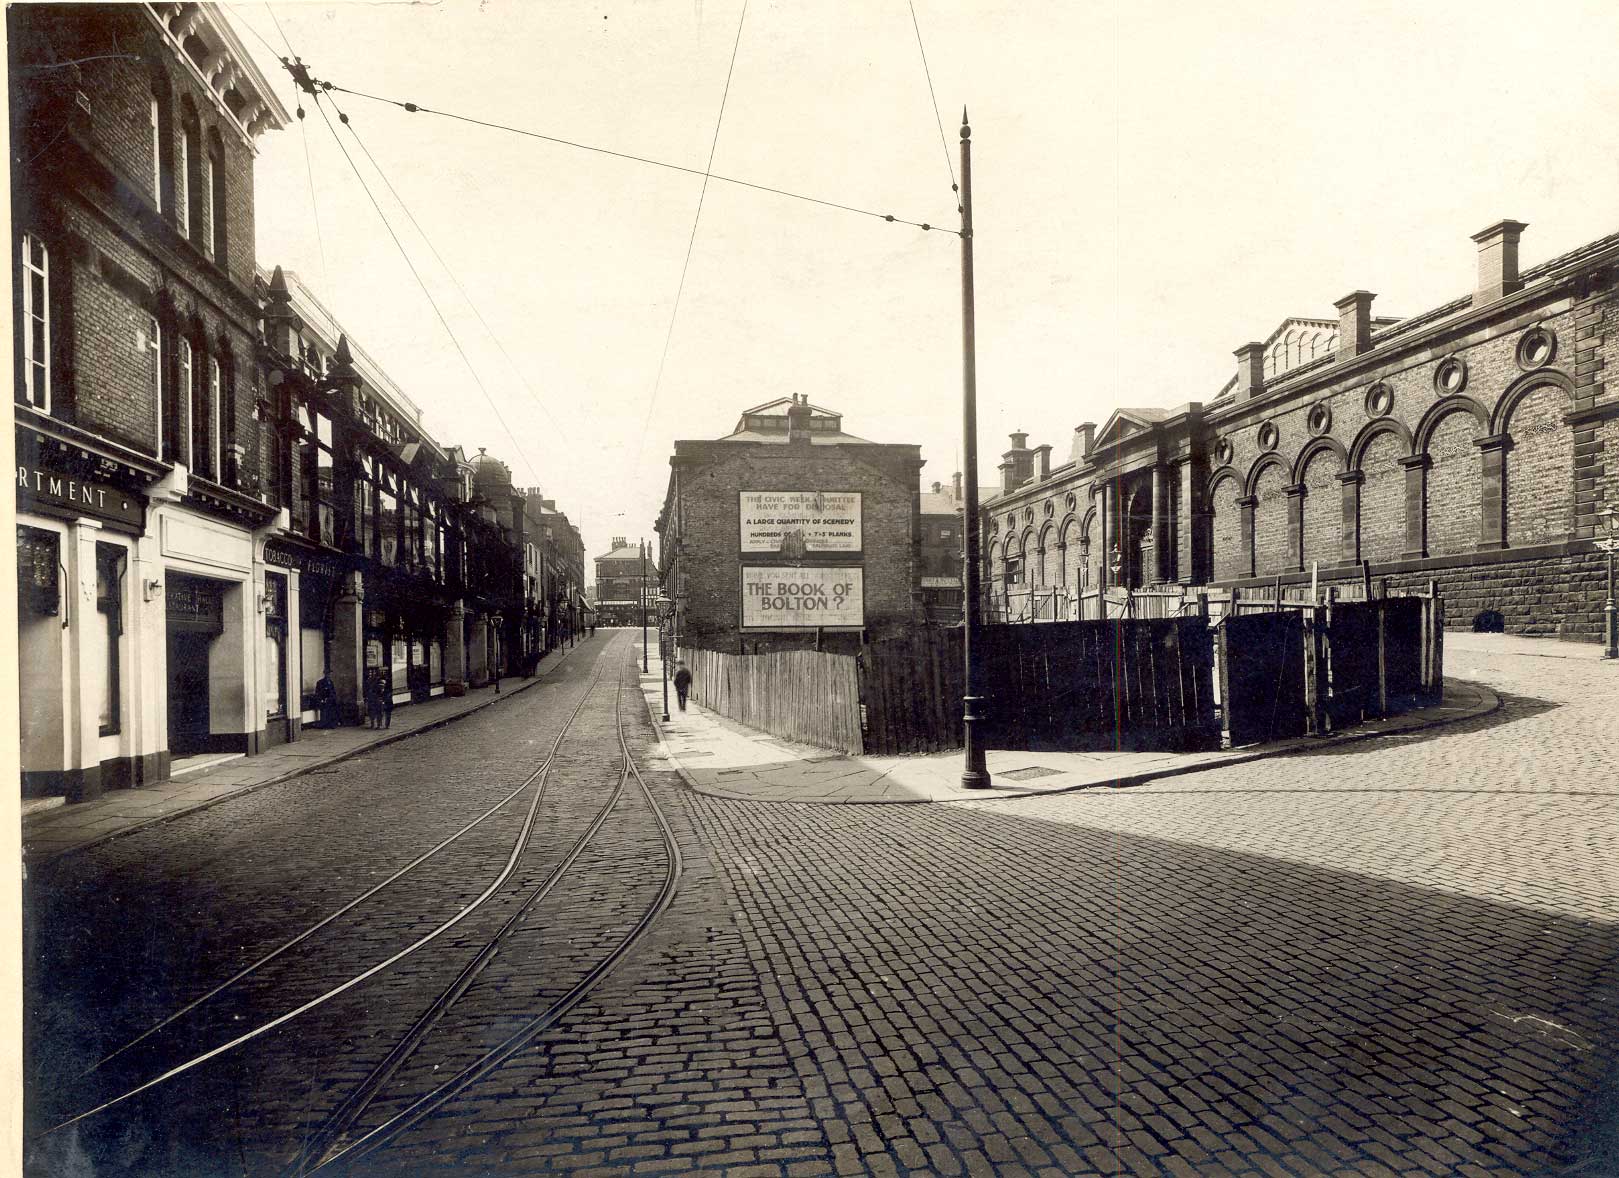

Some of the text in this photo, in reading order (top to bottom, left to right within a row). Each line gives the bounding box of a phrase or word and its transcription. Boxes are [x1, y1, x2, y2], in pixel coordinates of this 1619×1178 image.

[265, 547, 294, 567] TOBACCO
[746, 582, 854, 597] THE BOOK OF
[761, 595, 845, 611] BOLTON ?
